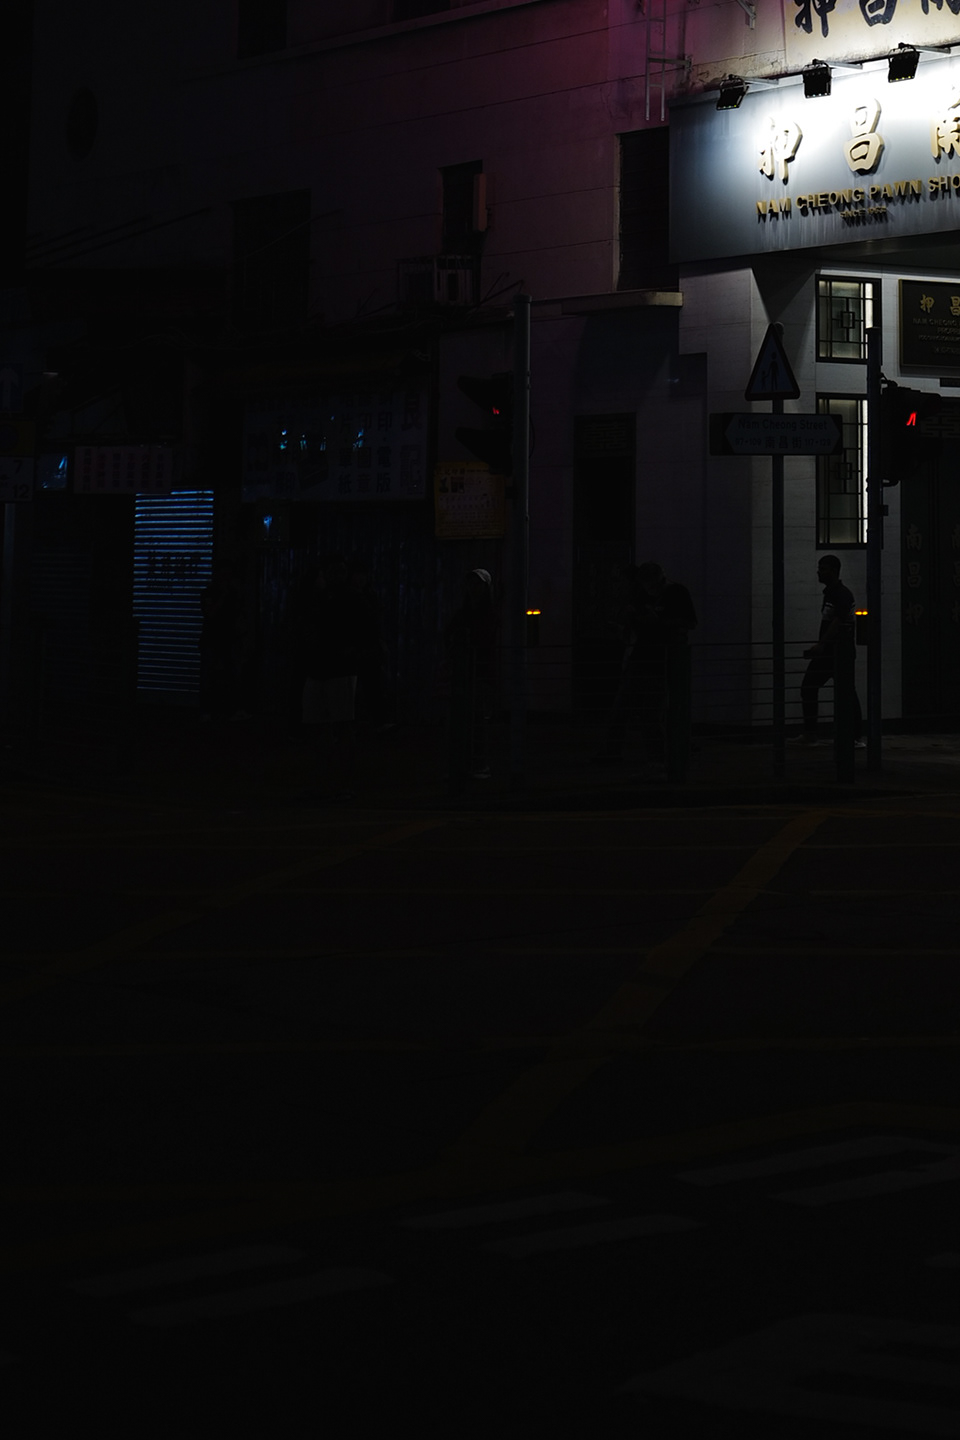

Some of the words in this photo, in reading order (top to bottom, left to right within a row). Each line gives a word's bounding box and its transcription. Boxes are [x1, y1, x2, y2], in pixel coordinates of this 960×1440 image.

[756, 197, 792, 216] NAM
[796, 188, 865, 210] CHEONG
[869, 179, 922, 200] PAWN
[738, 419, 760, 430] Nam
[762, 418, 797, 432] Cheong
[800, 418, 828, 430] Street
